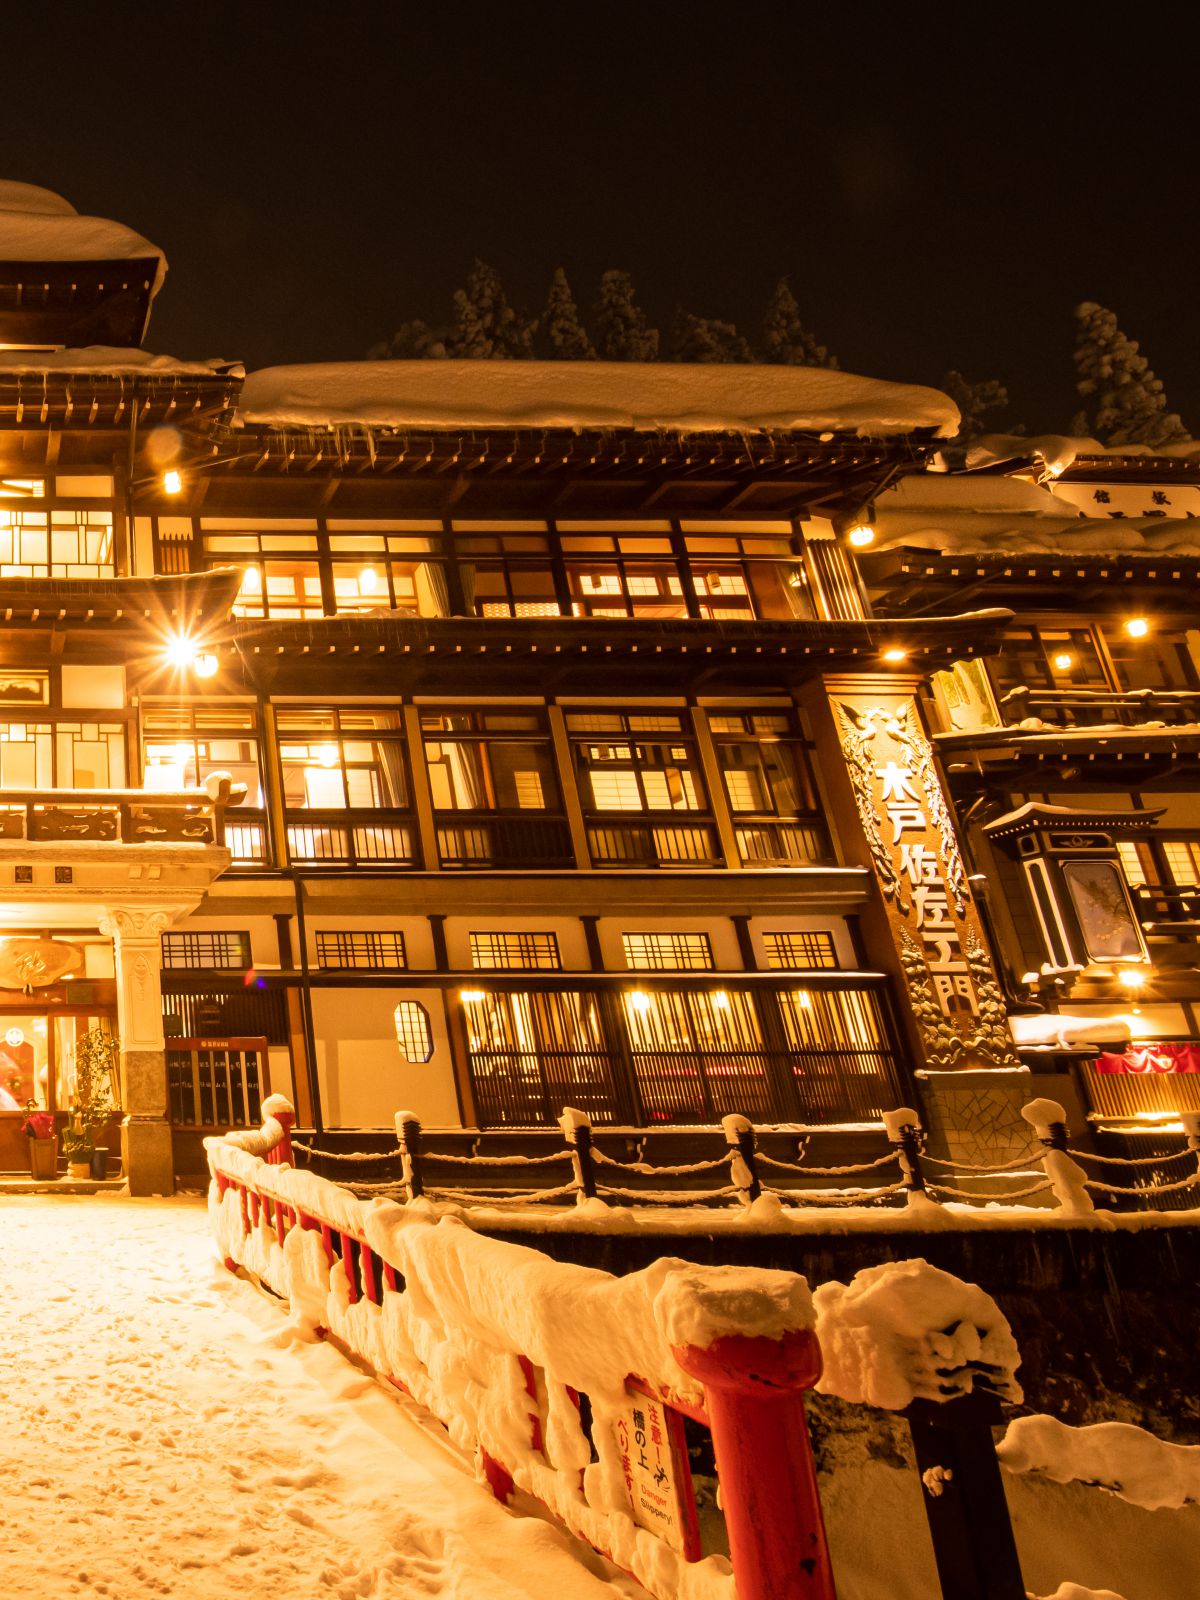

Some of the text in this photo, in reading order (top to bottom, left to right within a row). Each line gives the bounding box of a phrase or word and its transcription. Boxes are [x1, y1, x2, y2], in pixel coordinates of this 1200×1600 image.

[617, 1419, 636, 1513] べります!
[633, 1408, 650, 1470] 橋の上
[641, 1484, 667, 1507] Danger
